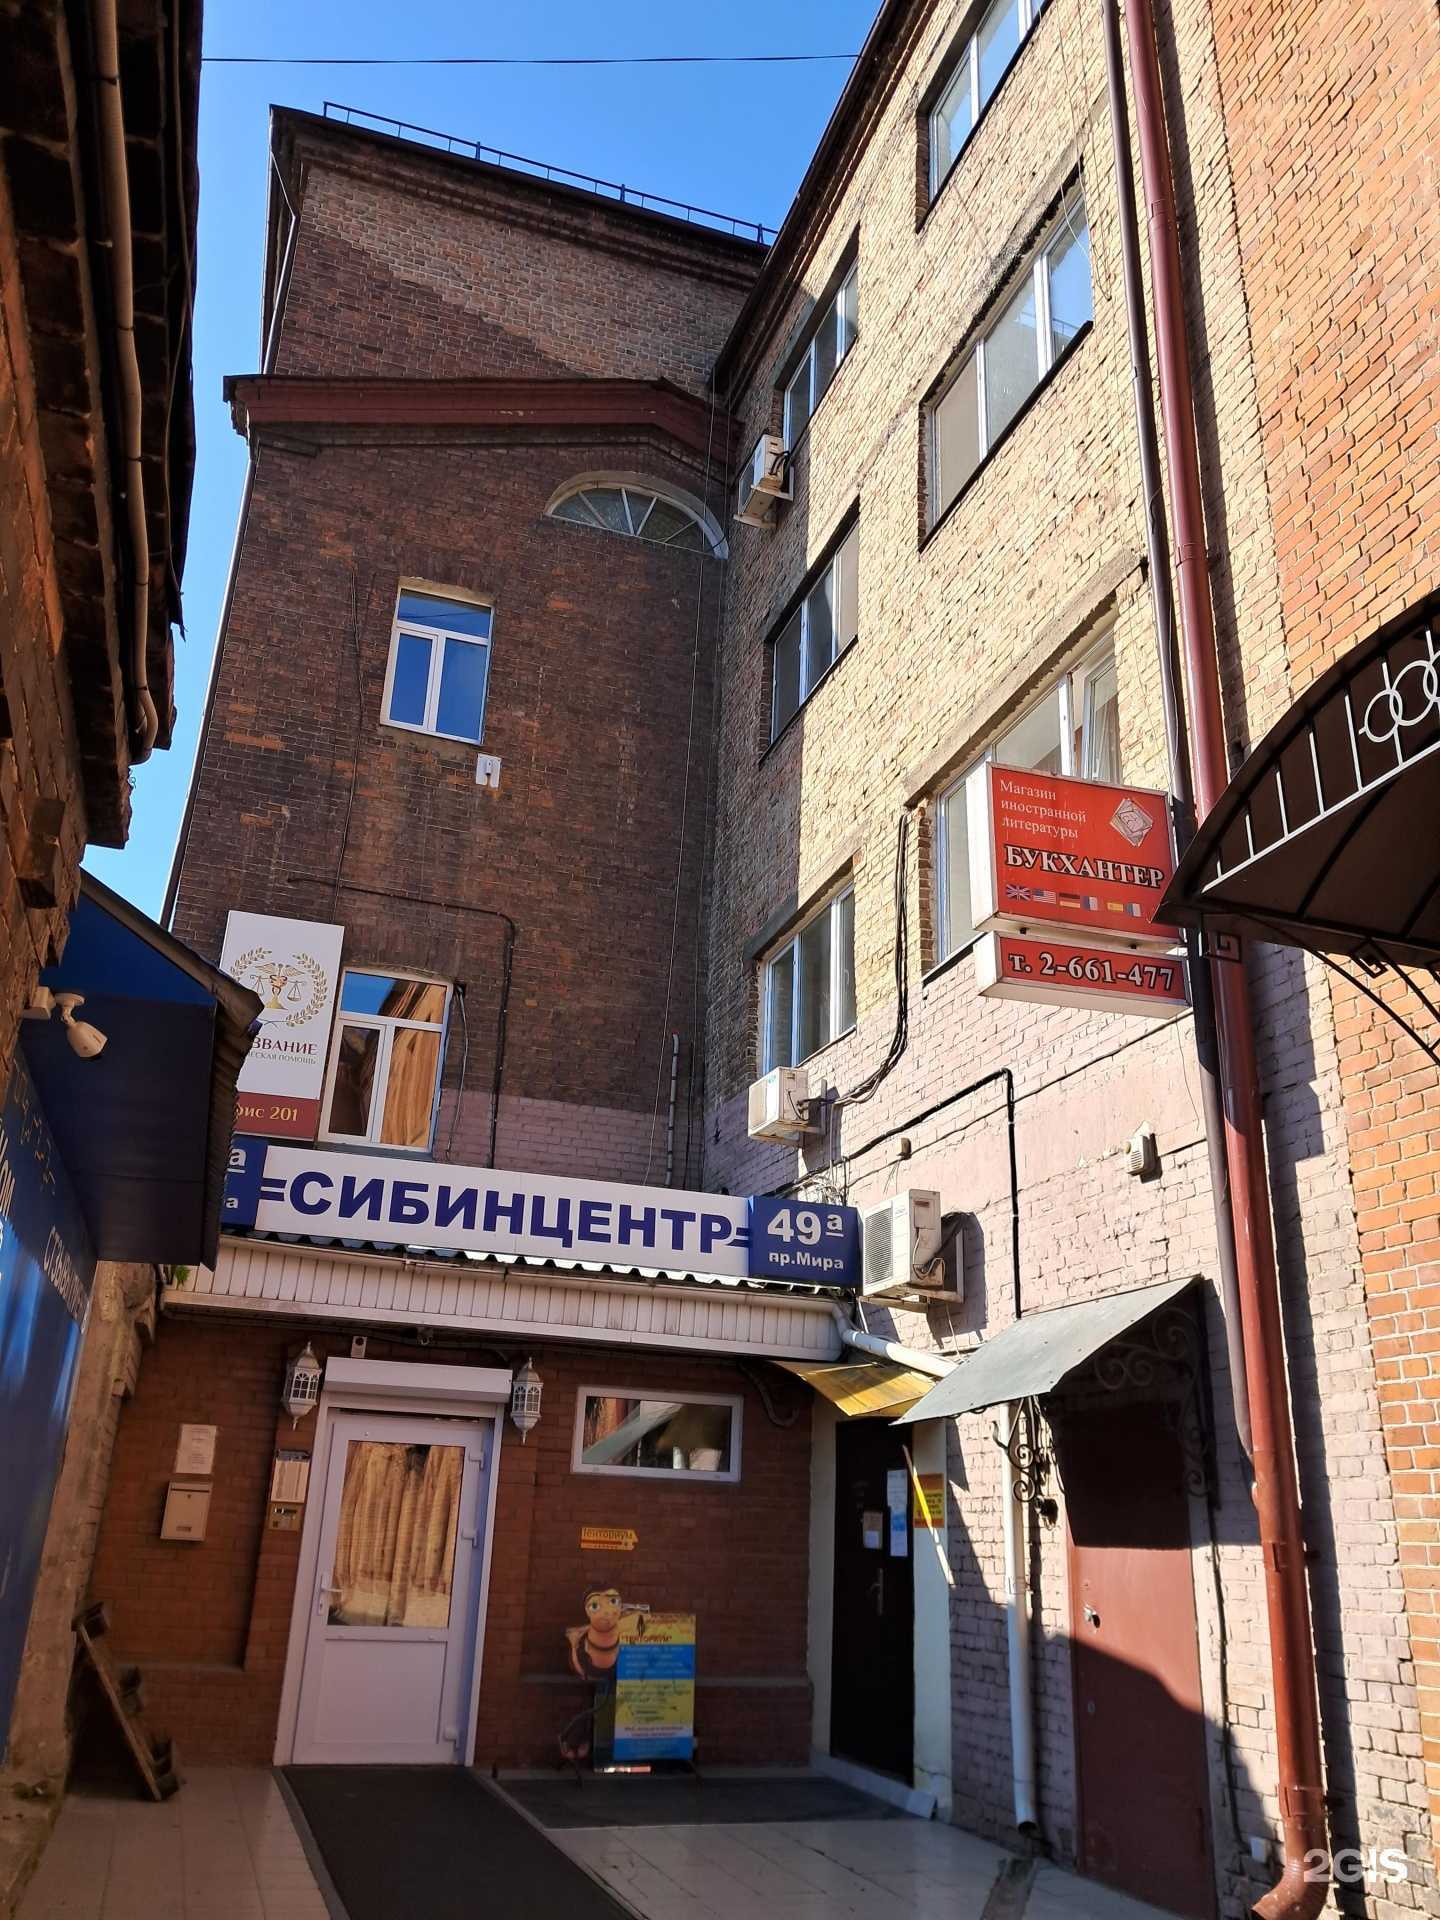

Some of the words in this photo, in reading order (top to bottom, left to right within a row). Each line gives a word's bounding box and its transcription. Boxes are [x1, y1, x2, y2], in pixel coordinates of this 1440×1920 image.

[1000, 779, 1056, 800] Магазин
[1001, 800, 1087, 824] иностранной
[1002, 817, 1078, 839] литературы
[1004, 844, 1164, 888] БУКХАНТЕР
[1008, 953, 1031, 974] т.
[1039, 952, 1174, 990] 2-661-477
[253, 1037, 317, 1056] ЗВАНИЕ
[236, 1103, 264, 1119] фис
[270, 1106, 298, 1121] 201
[289, 1171, 732, 1254] СИБИНЦЕНТР
[768, 1250, 844, 1271] пр.Мира
